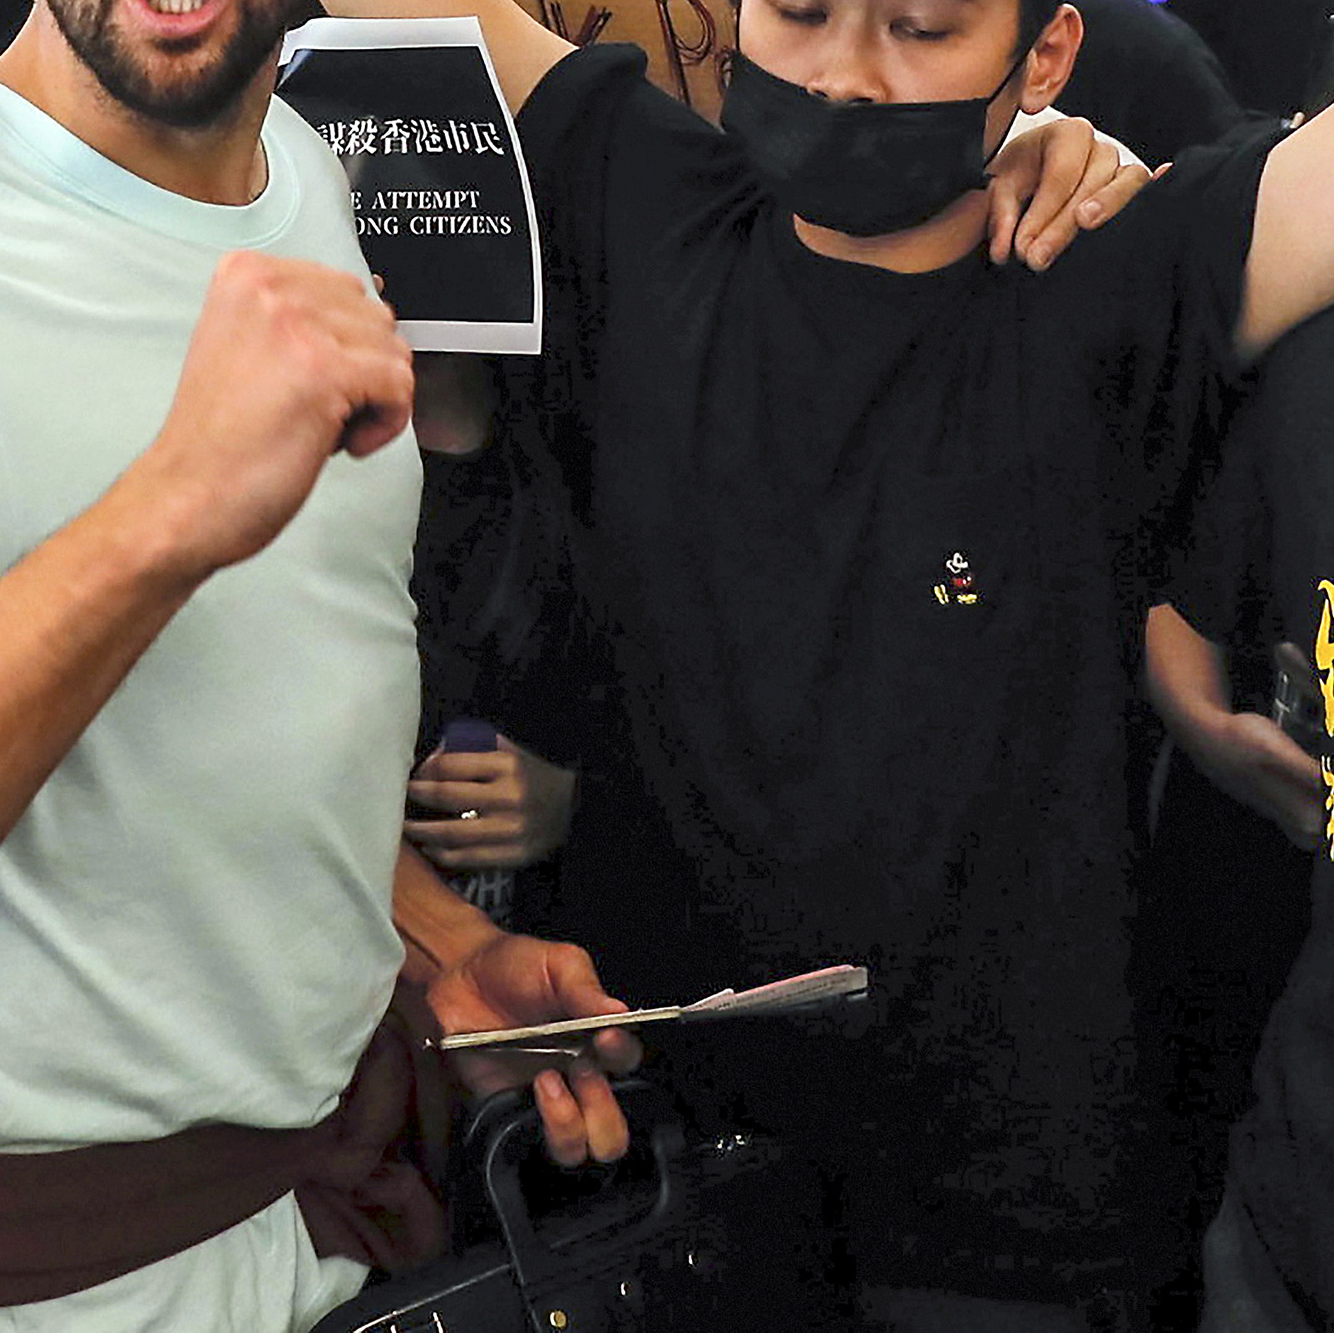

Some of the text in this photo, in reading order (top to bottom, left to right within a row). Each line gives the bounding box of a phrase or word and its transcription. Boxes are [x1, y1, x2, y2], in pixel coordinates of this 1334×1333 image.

[372, 191, 480, 209] ATTEMPT
[355, 216, 513, 235] ONG CITIZENS
